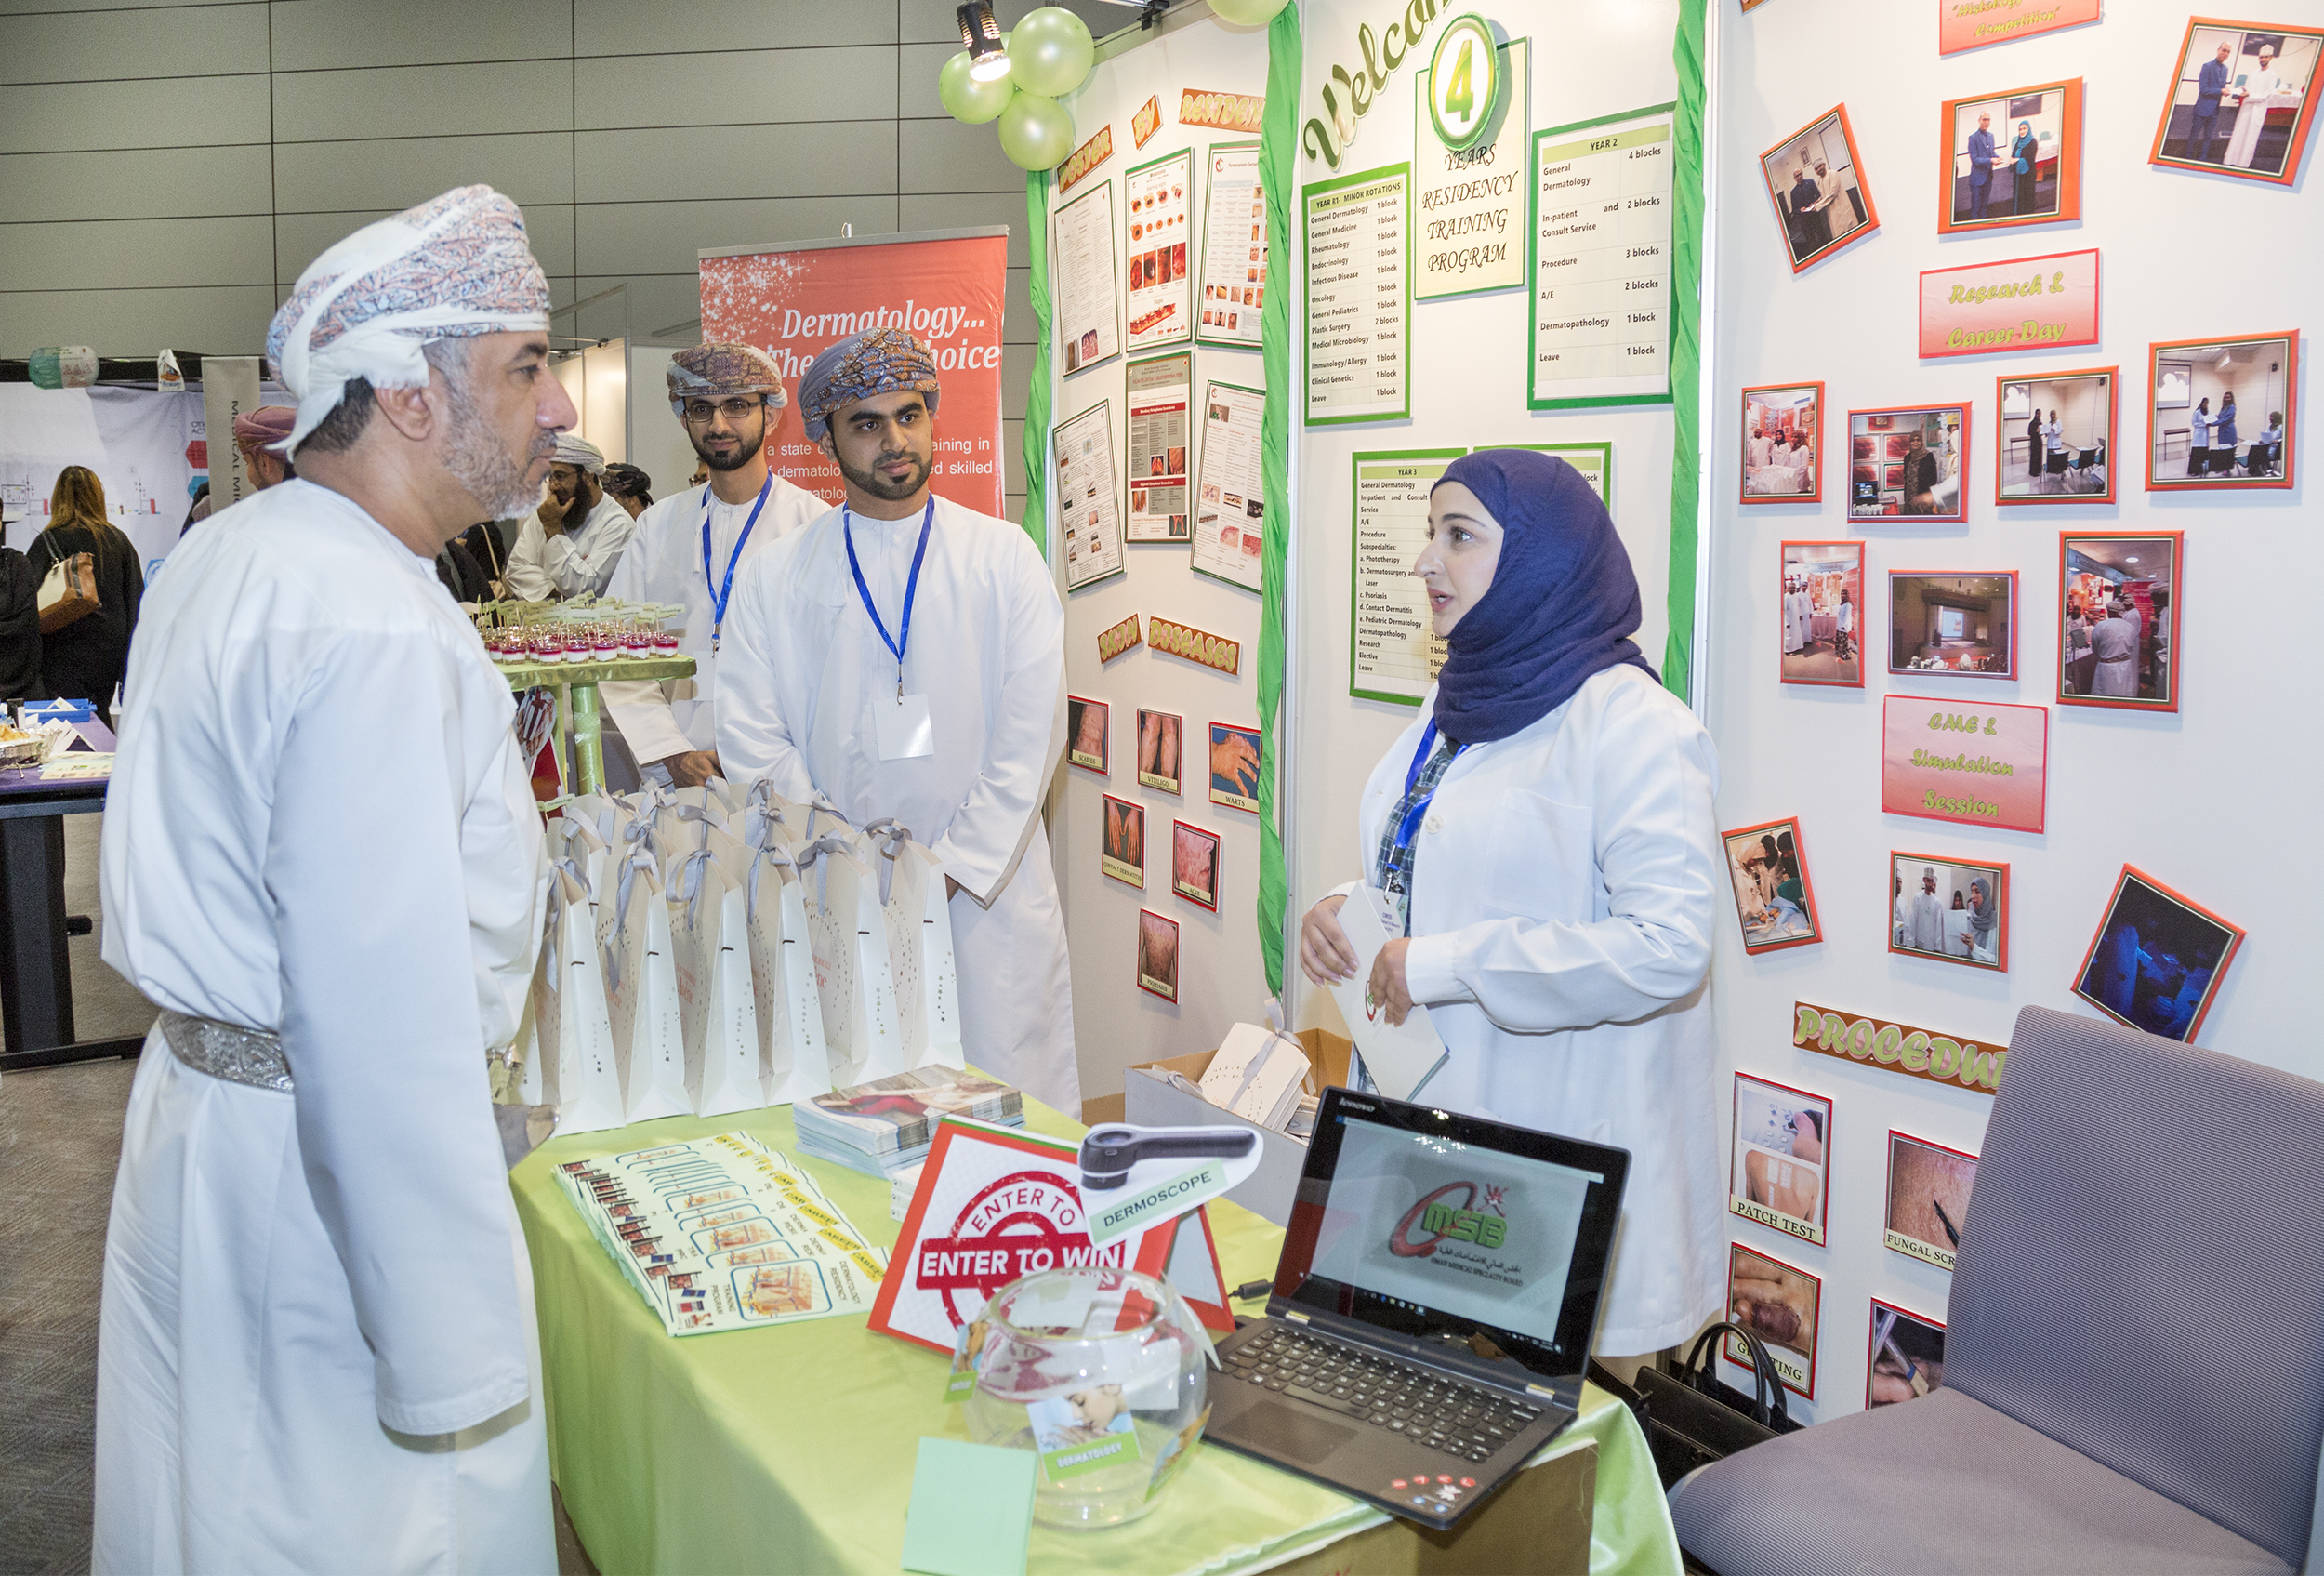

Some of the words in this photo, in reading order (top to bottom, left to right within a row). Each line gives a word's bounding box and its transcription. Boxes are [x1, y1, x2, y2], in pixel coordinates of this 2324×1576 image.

[1303, 0, 1451, 168] Welco
[1445, 39, 1474, 123] 4
[1058, 129, 1111, 192] POSTER
[1134, 97, 1155, 144] BY
[1181, 93, 1265, 127] RESIDEN
[1591, 139, 1610, 151] YEAR
[1613, 139, 1618, 147] 2
[1444, 143, 1498, 172] YEARS
[1629, 152, 1633, 160] 4
[1636, 147, 1661, 159] blocks
[1543, 163, 1571, 176] General
[1422, 171, 1518, 209] RESIDENCY
[1543, 177, 1591, 191] Dermatology
[1316, 197, 1330, 208] YEAR
[1344, 191, 1365, 202] MINOR
[1366, 182, 1401, 196] ROTATIONS
[1381, 198, 1398, 208] block
[1627, 201, 1631, 209] 2
[1634, 196, 1660, 207] blocks
[1311, 214, 1331, 224] General
[1332, 205, 1368, 219] Dermatology
[1381, 214, 1398, 224] block
[1543, 209, 1578, 223] In-patient
[1604, 202, 1618, 213] and
[1312, 228, 1331, 239] General
[1332, 223, 1357, 234] Medicine
[1427, 208, 1509, 241] TRAINING
[1542, 227, 1568, 238] Consult
[1570, 222, 1596, 233] Service
[1312, 241, 1350, 254] Rheumatology
[1626, 249, 1631, 258] 3
[1633, 246, 1659, 257] blocks
[1312, 258, 1349, 270] Endocrinology
[1428, 242, 1507, 273] PROGRAM
[1541, 257, 1578, 269] Procedure
[1381, 263, 1397, 273] block
[1312, 274, 1337, 286] Infectious
[1338, 271, 1359, 281] Disease
[1632, 280, 1658, 290] blocks
[1949, 274, 2042, 304] Research
[2049, 271, 2065, 294] &
[1312, 294, 1336, 303] Oncology
[1541, 291, 1553, 300] A/E
[1312, 310, 1331, 319] General
[1331, 306, 1359, 316] Pediatrics
[1627, 314, 1631, 323] 1
[1633, 312, 1656, 323] block
[1380, 315, 1399, 324] blocks
[1540, 318, 1610, 330] Dermatopathology
[1312, 324, 1328, 335] Plastic
[1329, 323, 1351, 331] Surgery
[1948, 327, 2014, 348] Career
[2020, 320, 2067, 342] Day
[1312, 339, 1331, 350] Medical
[1332, 336, 1370, 346] Microbiology
[925, 339, 1000, 371] hoice
[1633, 345, 1655, 355] block
[1312, 357, 1367, 369] Immunology/Allergy
[1380, 352, 1397, 362] block
[1539, 353, 1560, 362] Leave
[1312, 376, 1330, 385] Clinical
[1331, 375, 1354, 383] Genetics
[1380, 388, 1397, 396] block
[767, 446, 775, 456] a
[781, 444, 812, 456] state
[932, 439, 971, 455] aining
[978, 437, 990, 450] in
[778, 465, 841, 478] dermatolo
[949, 460, 993, 474] skilled
[1381, 482, 1415, 490] Dermatology
[1366, 555, 1400, 564] Phototherapy
[1366, 568, 1407, 577] Dermatosurgery
[1386, 605, 1413, 614] Dermatitis
[1388, 618, 1422, 629] Dermatology
[1359, 628, 1406, 640] Dermatopathology
[1435, 634, 1449, 642] bloc
[1099, 616, 1138, 660] SKIN
[1149, 619, 1237, 671] DISEASES
[1359, 640, 1380, 648] Research
[1359, 652, 1378, 660] Elective
[1358, 664, 1373, 672] Leave
[1928, 712, 1979, 734] CME
[1984, 716, 1997, 735] &
[1911, 748, 2014, 776] Simulation
[1147, 775, 1169, 788] VITILIGO
[1224, 795, 1246, 807] WARTS
[1923, 789, 1999, 817] Session
[1339, 1097, 1375, 1113] lenovo
[1103, 1171, 1212, 1228] DERMOSCOPE
[971, 1187, 1044, 1233] ENTER
[1050, 1196, 1076, 1227] TO
[1737, 1201, 1778, 1226] PATCH
[1782, 1219, 1816, 1239] TEST
[1887, 1233, 1931, 1257] FUNGAL
[1934, 1250, 1956, 1265] SCR
[921, 1250, 1009, 1278] ENTER
[1016, 1248, 1054, 1273] TO
[1062, 1245, 1121, 1270] WIN
[1737, 1342, 1802, 1382] GTING
[1056, 1442, 1123, 1469] DERMATOLOGY
